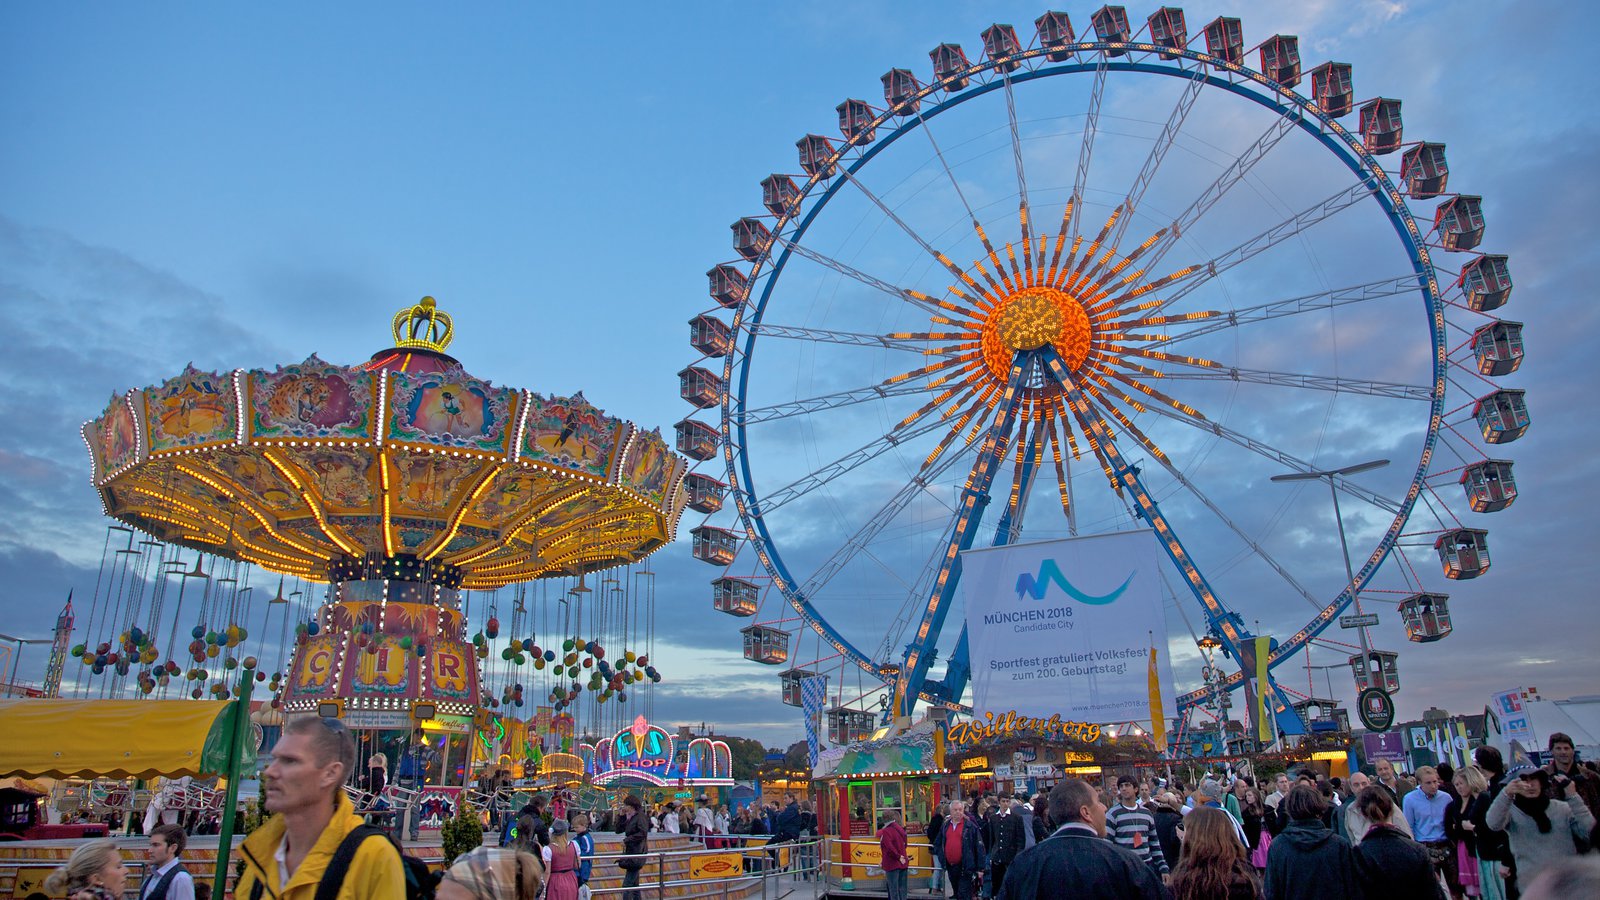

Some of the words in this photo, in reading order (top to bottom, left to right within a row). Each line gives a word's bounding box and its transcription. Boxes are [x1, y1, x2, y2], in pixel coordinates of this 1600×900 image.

[984, 609, 1045, 625] MÜNCHEN
[1047, 606, 1073, 618] 2018
[1014, 622, 1056, 633] Candidate
[1057, 620, 1074, 632] City
[990, 654, 1040, 670] Sportfest
[1042, 652, 1093, 667] gratuliert
[1095, 647, 1148, 661] Volksfest
[1012, 671, 1035, 681] zum
[1036, 669, 1059, 679] 200.
[1061, 663, 1127, 678] Geburtstag!
[1072, 700, 1149, 711] www.muenchen2018.or
[947, 710, 1101, 744] Willenborg
[615, 758, 668, 769] SHOP
